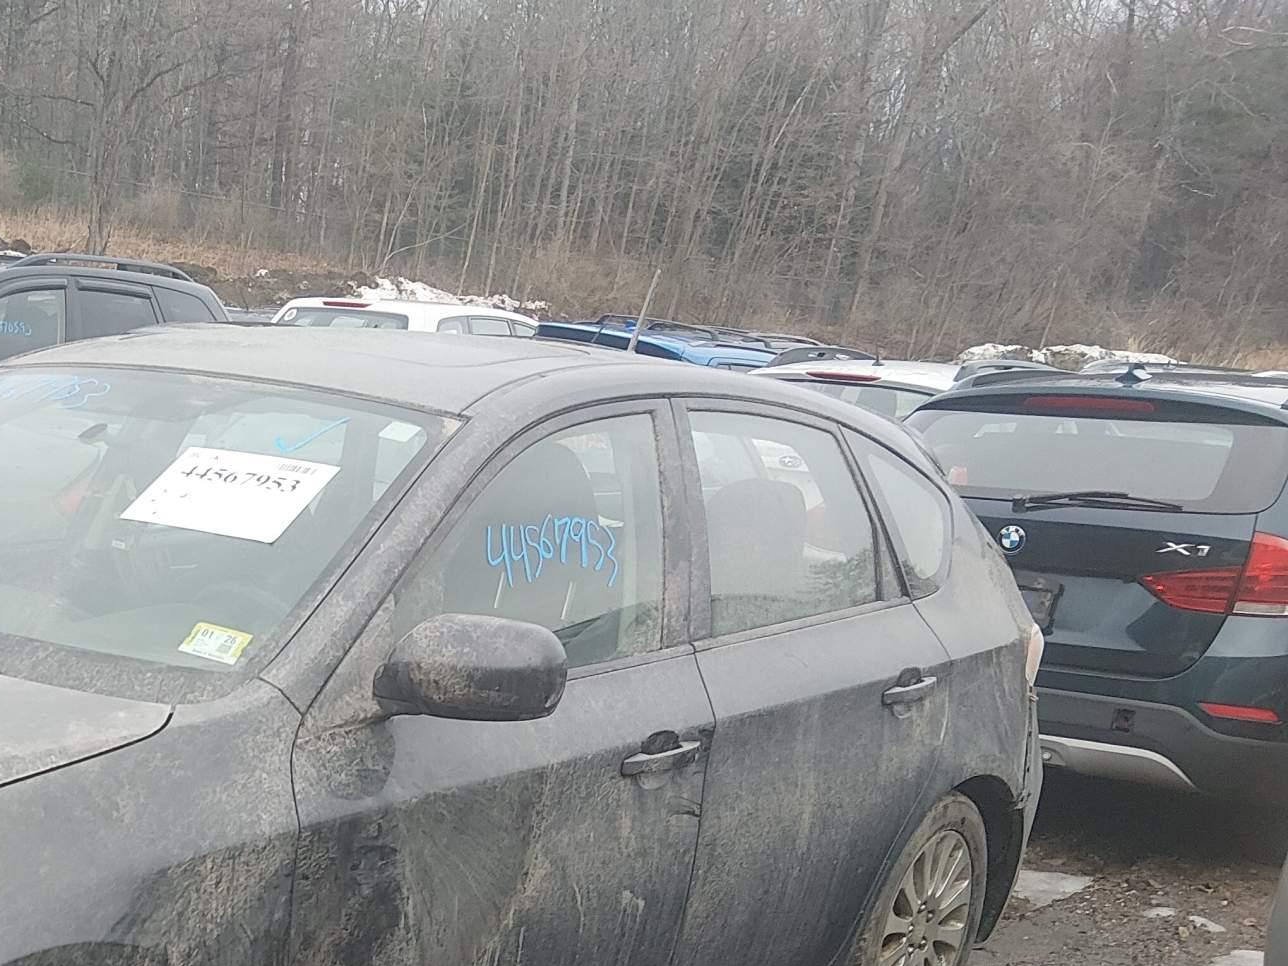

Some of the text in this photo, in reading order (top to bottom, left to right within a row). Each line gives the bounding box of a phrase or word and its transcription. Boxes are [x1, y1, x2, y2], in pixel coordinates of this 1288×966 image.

[181, 465, 301, 493] 44567953
[486, 513, 619, 588] 44567953
[1155, 541, 1211, 557] X1
[200, 628, 215, 639] 01
